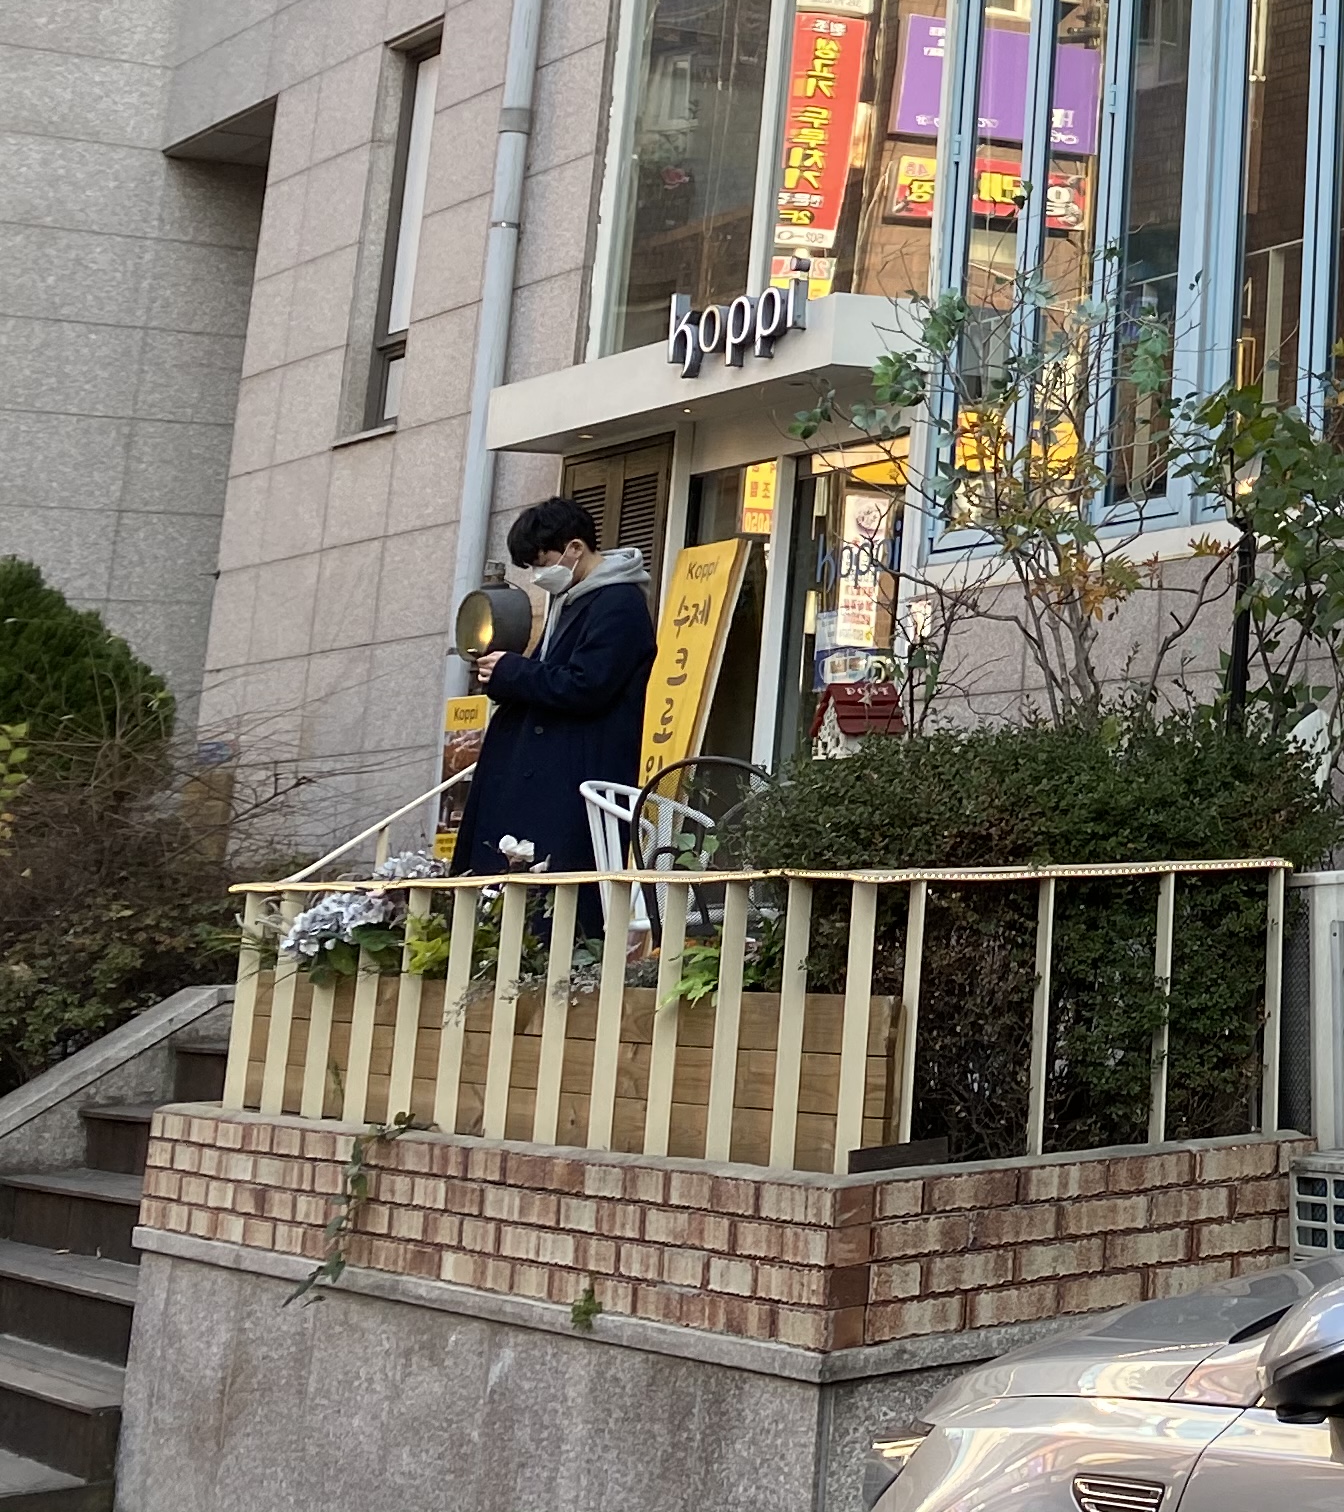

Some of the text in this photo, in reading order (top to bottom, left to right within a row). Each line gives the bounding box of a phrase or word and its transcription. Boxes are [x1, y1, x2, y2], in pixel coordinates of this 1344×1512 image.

[686, 556, 720, 583] Koppi
[673, 595, 712, 639] 수제
[453, 706, 479, 725] Koppi
